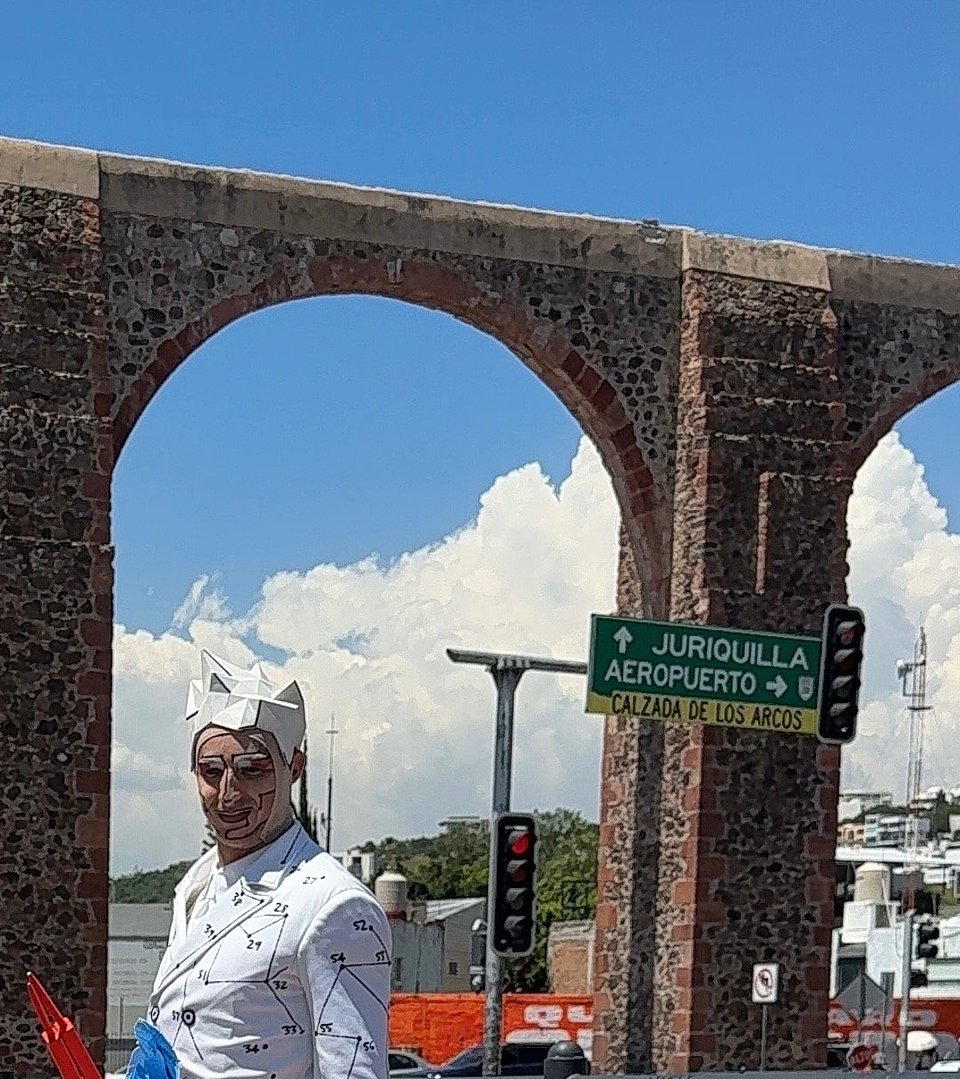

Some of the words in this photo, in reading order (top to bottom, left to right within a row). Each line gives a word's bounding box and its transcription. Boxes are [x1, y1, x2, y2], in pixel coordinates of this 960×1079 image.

[651, 633, 810, 670] JURIQUILLA
[604, 659, 757, 696] AEROPUERTO
[611, 694, 682, 719] CALZADA
[688, 700, 709, 721] DE
[715, 703, 745, 724] LOS
[751, 709, 803, 730] ARCOS
[353, 919, 368, 931] 52
[246, 939, 262, 951] 29
[330, 952, 346, 963] 54
[273, 980, 288, 990] 32
[281, 1025, 297, 1035] 33
[320, 1023, 333, 1033] 55
[243, 1044, 260, 1054] 34
[363, 1042, 375, 1052] 56
